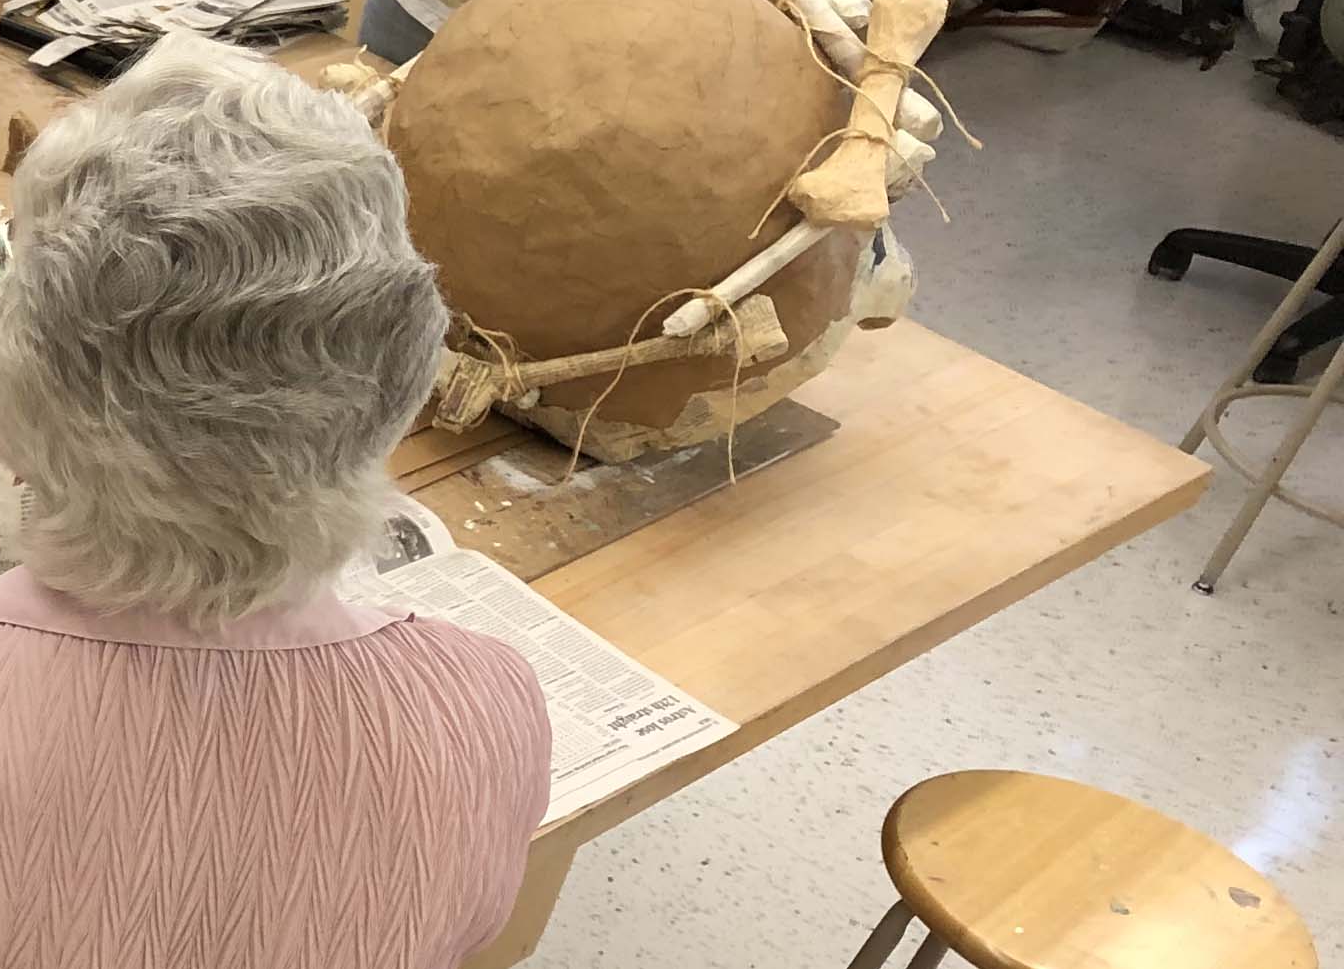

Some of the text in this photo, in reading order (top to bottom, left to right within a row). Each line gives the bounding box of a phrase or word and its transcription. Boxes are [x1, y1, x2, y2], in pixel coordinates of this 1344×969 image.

[651, 694, 681, 710] 12th
[606, 706, 654, 732] straight
[635, 704, 697, 737] Astros lose
